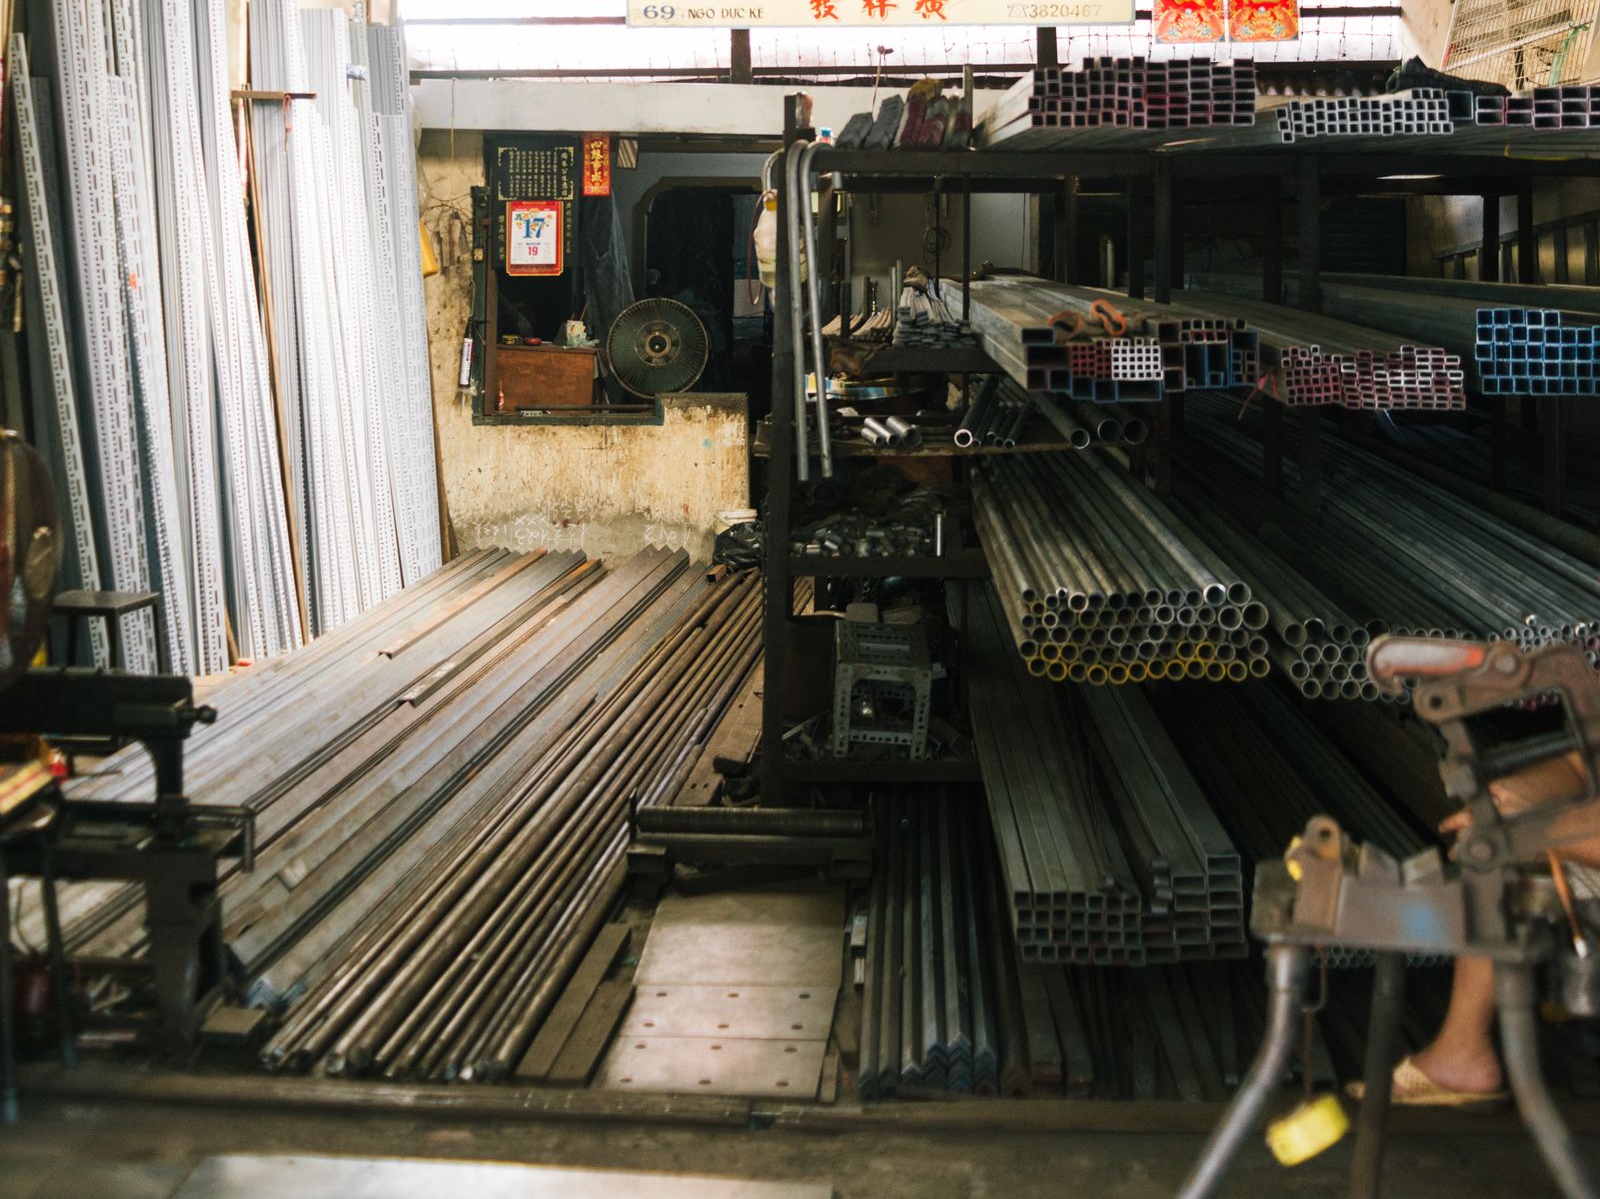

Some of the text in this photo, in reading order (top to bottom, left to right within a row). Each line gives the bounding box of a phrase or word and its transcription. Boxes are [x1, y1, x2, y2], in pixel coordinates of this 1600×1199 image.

[642, 5, 676, 20] 69
[1028, 3, 1104, 19] 3820467
[522, 218, 545, 239] 17
[528, 246, 538, 256] 19
